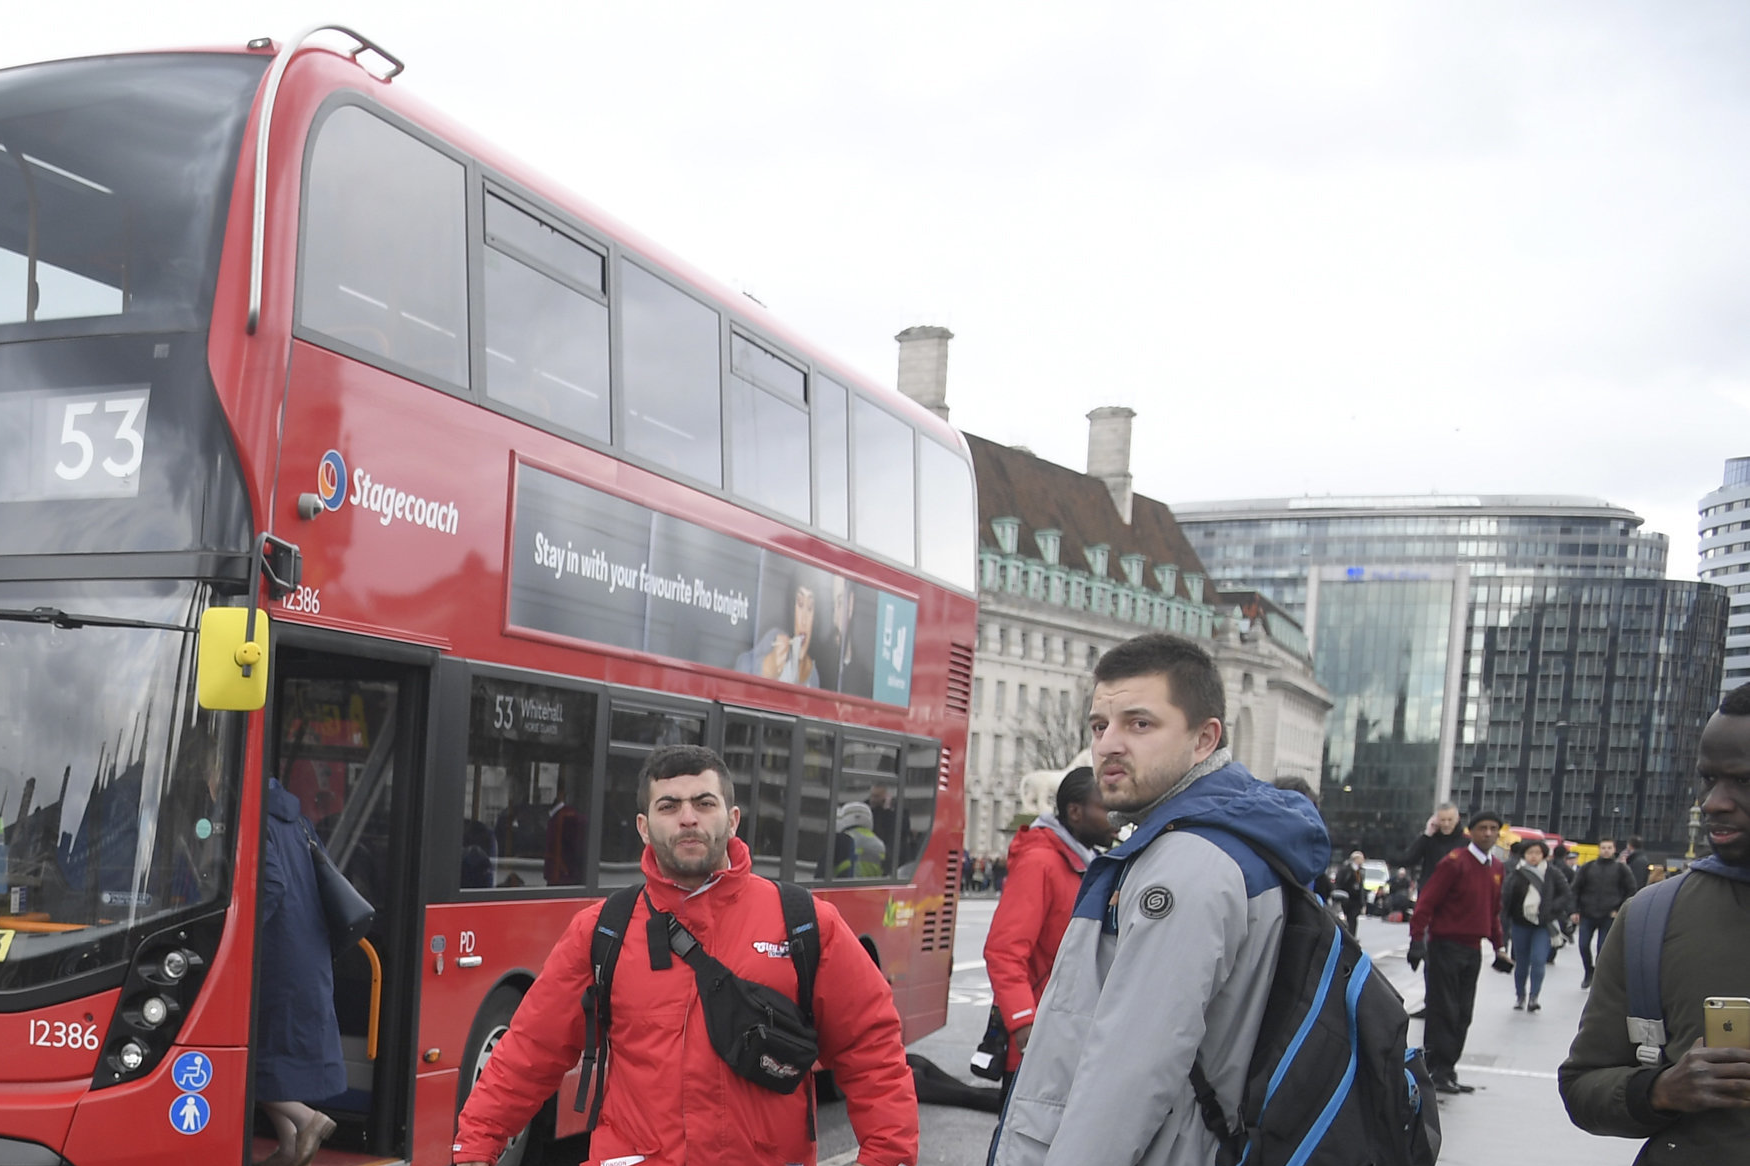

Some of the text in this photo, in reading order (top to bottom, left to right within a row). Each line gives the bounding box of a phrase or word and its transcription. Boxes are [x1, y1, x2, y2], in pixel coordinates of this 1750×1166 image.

[54, 397, 146, 481] 53
[349, 467, 459, 535] Stagecoach
[534, 531, 749, 626] Stay in with your favourite Pho tonight
[494, 695, 564, 730] 53 Whitehall
[459, 930, 476, 953] PD
[29, 1018, 100, 1051] 12386
